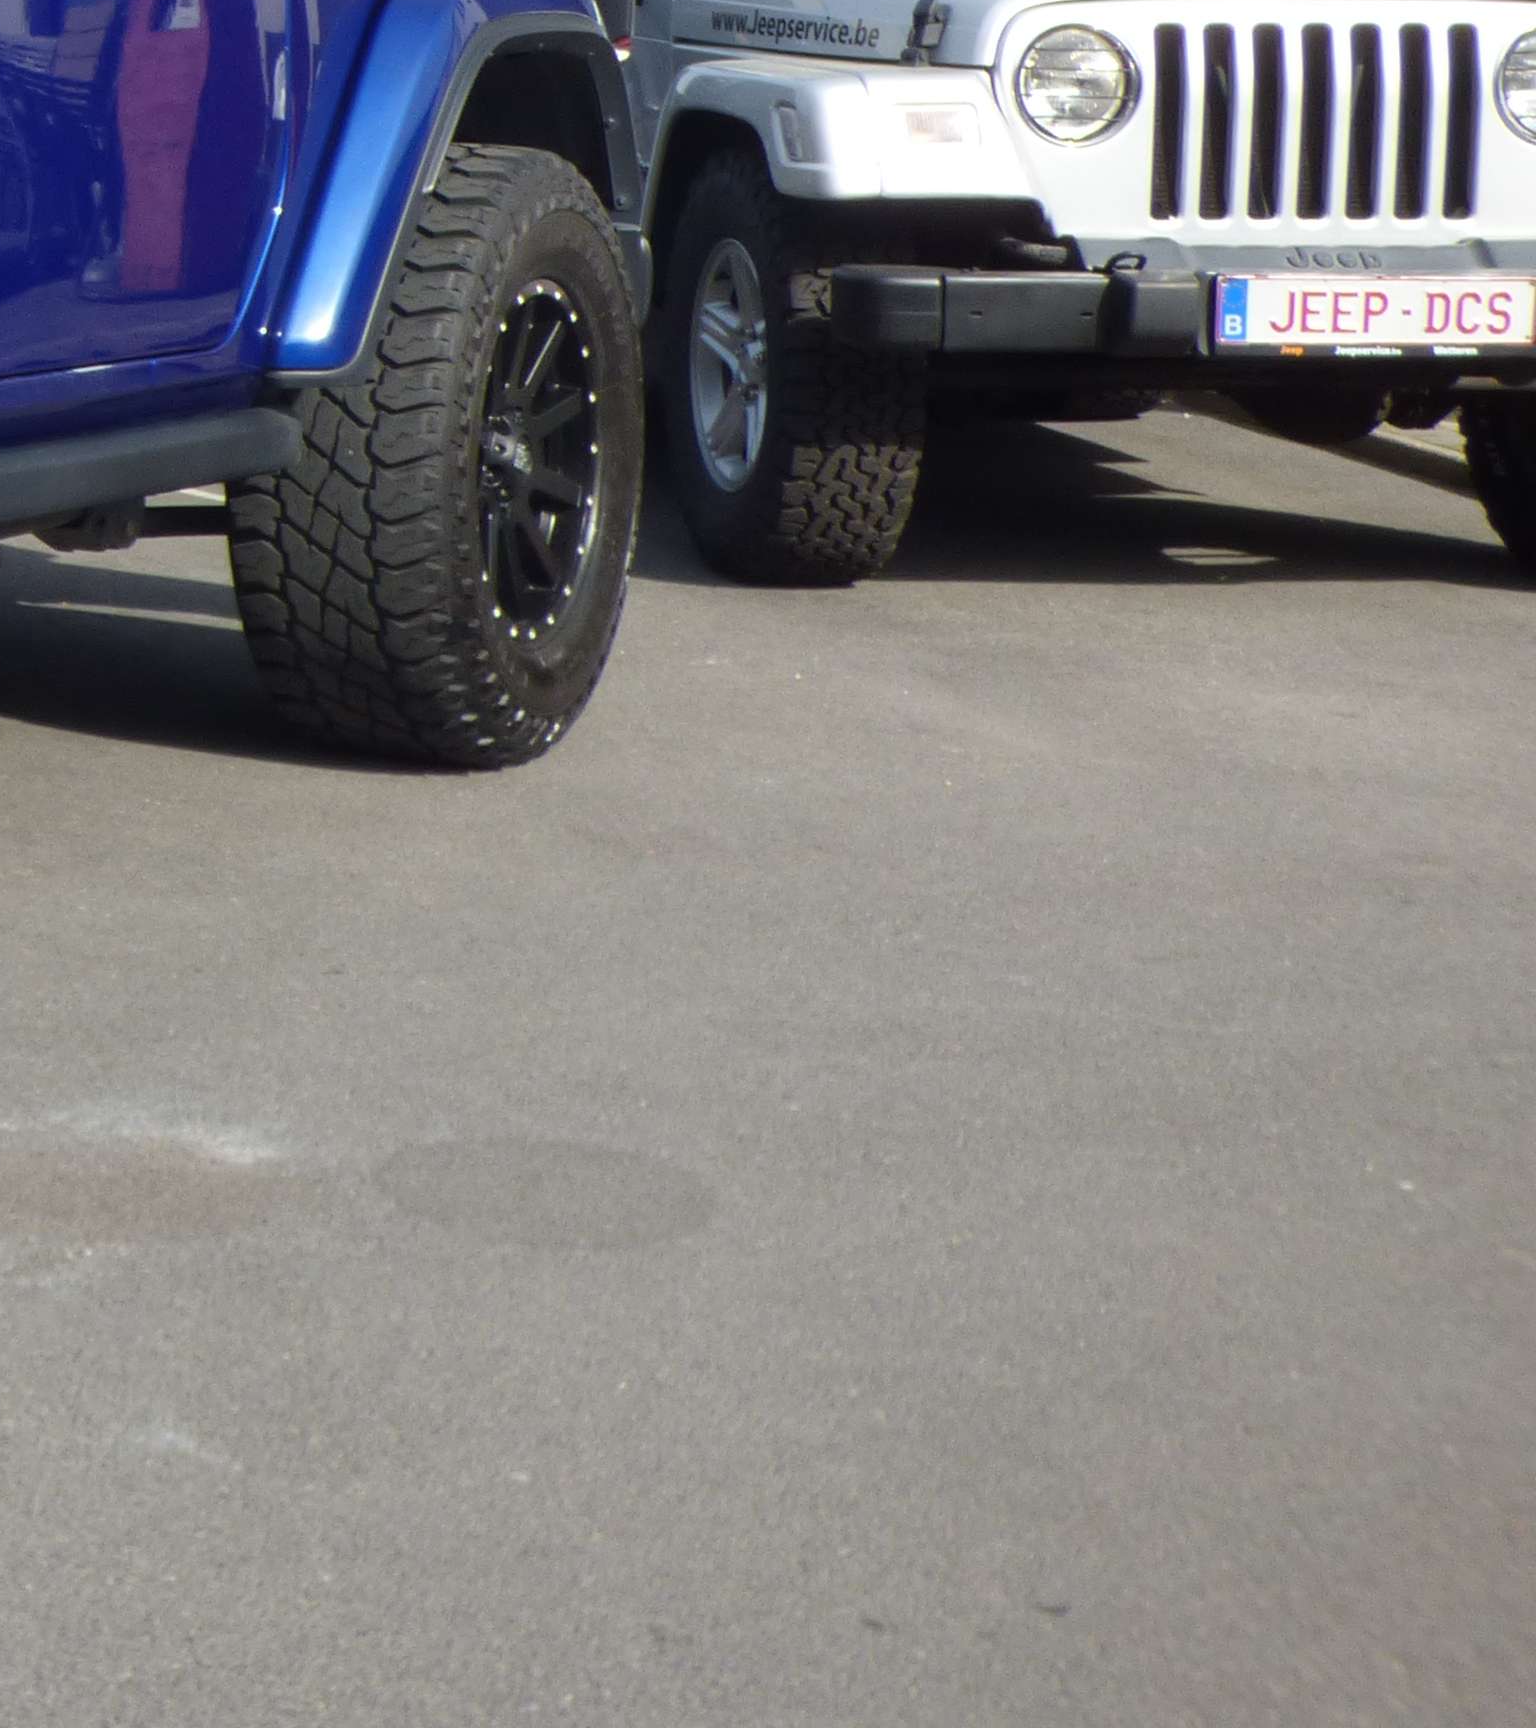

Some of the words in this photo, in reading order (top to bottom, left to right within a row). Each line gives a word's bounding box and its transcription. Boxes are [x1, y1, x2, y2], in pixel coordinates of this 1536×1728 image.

[711, 9, 880, 48] www.Jeepservice.be
[1285, 246, 1384, 270] Jeep
[1224, 315, 1243, 335] B
